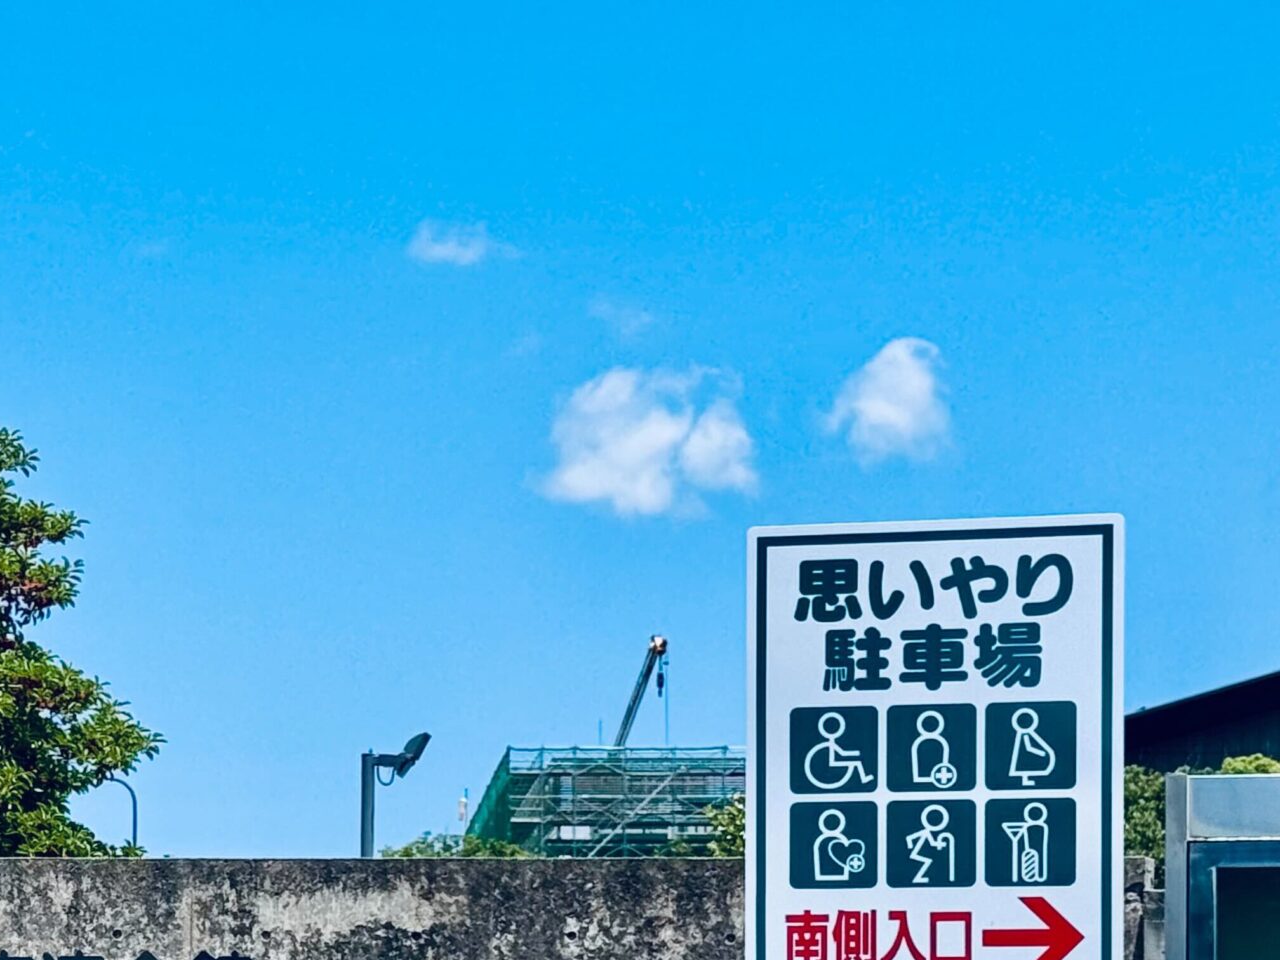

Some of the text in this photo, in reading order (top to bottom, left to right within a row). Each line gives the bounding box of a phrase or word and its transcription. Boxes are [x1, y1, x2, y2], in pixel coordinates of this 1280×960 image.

[794, 553, 1074, 622] 思いやり
[822, 622, 1043, 691] 駐車場
